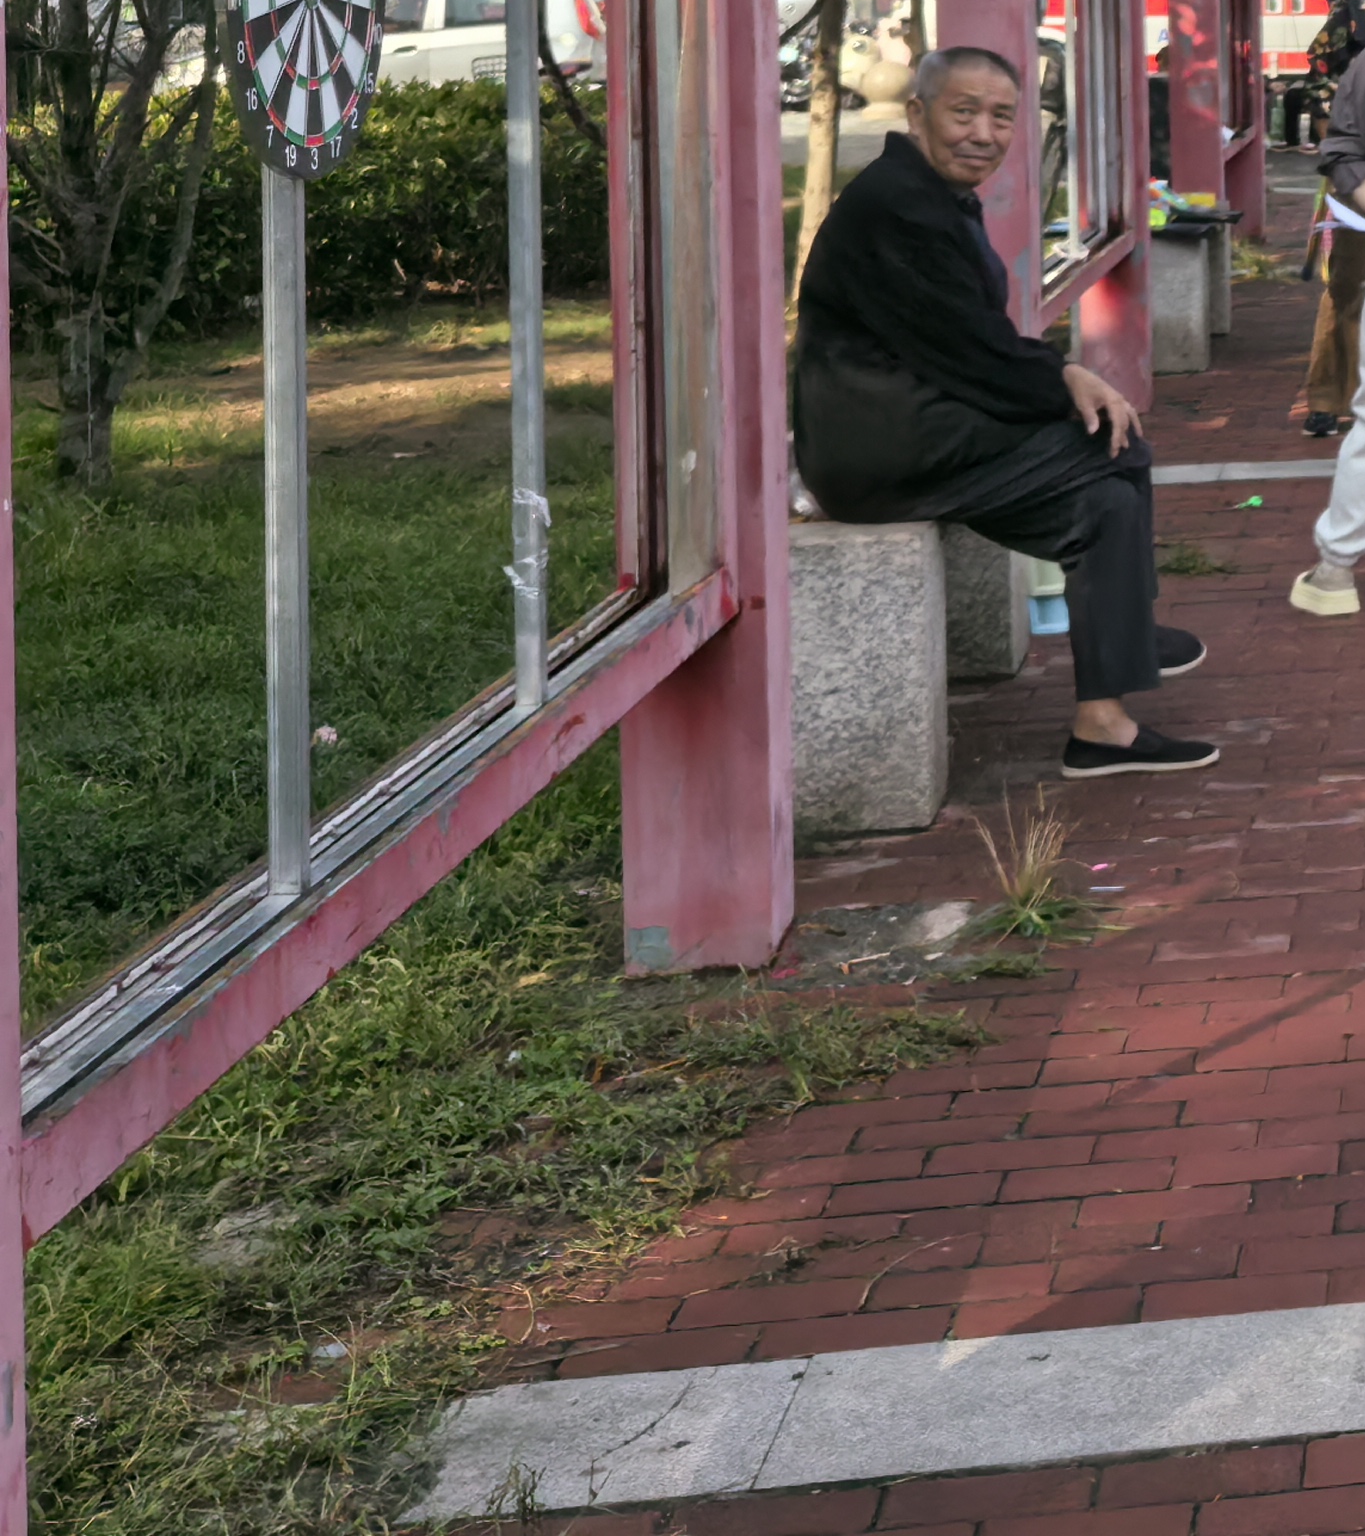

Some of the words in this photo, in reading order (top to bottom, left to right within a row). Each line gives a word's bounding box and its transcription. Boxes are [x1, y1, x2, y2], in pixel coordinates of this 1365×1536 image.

[237, 40, 245, 64] 8
[364, 72, 374, 94] 15
[245, 87, 258, 111] 16
[351, 107, 358, 130] 2
[266, 125, 274, 149] 7
[330, 135, 342, 159] 17
[284, 144, 297, 168] 19
[310, 147, 318, 170] 3
